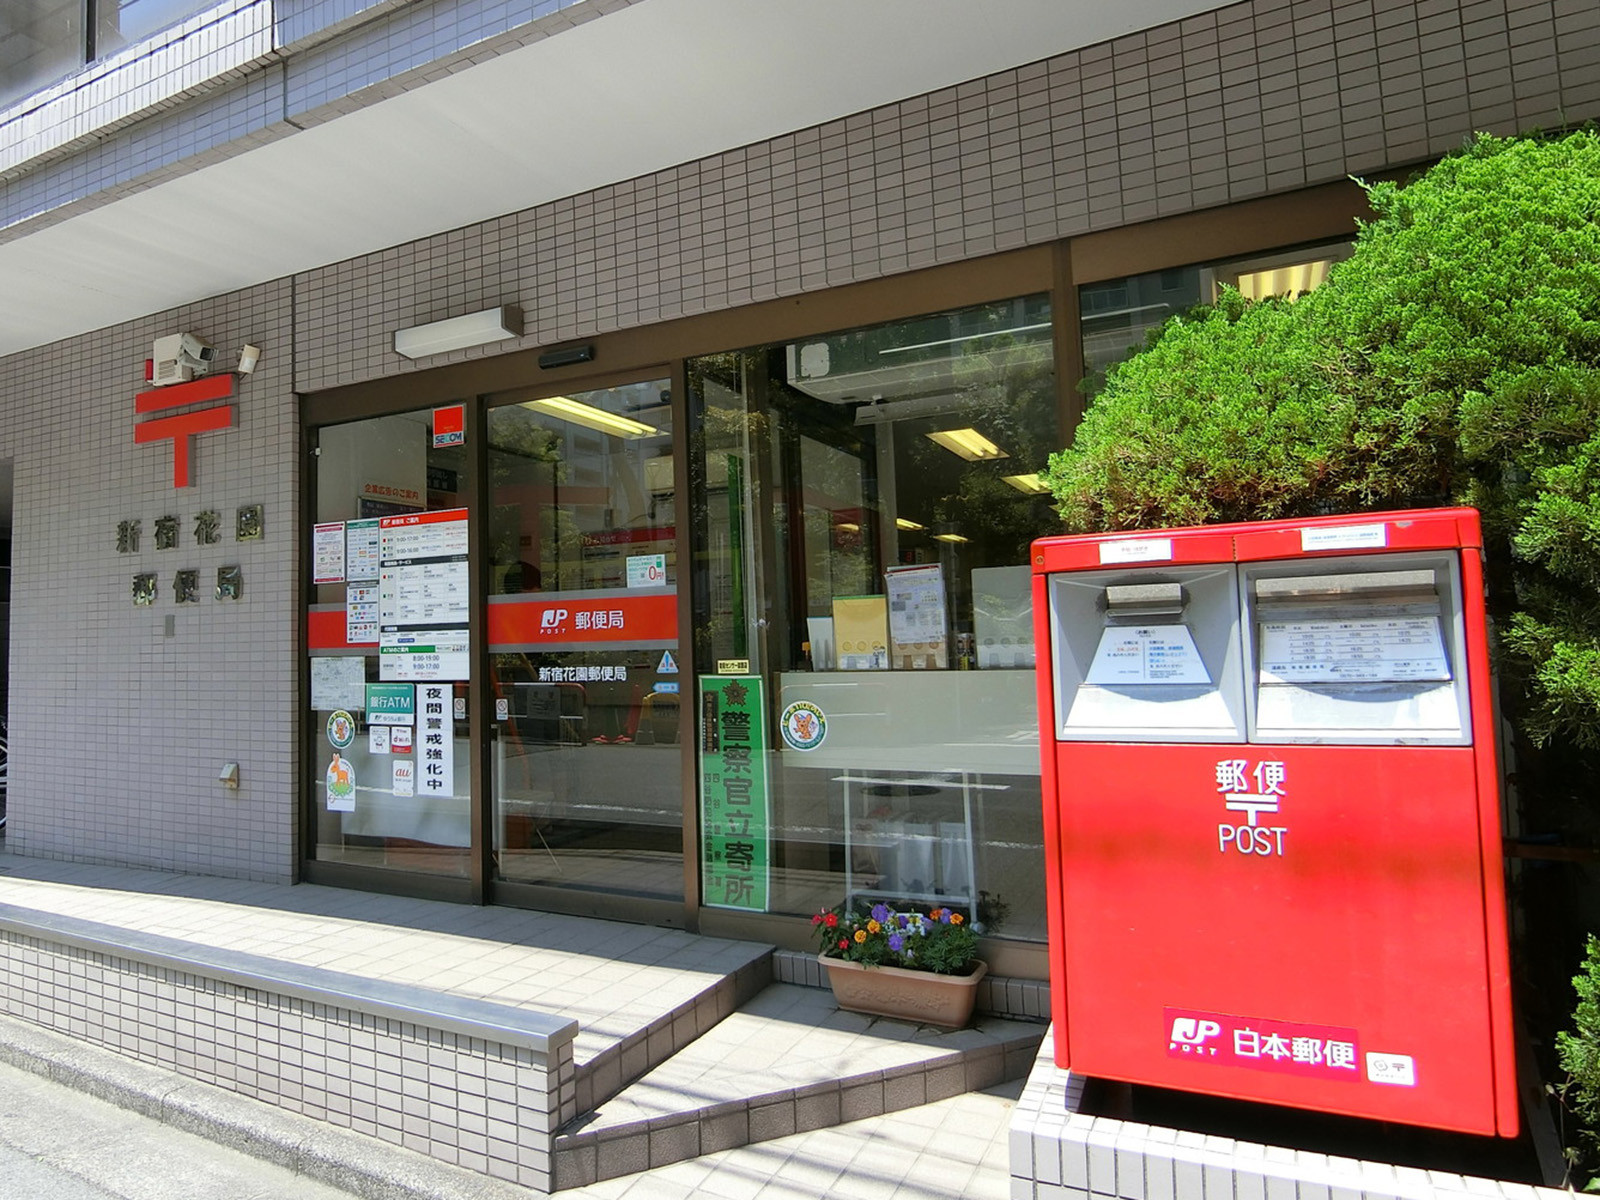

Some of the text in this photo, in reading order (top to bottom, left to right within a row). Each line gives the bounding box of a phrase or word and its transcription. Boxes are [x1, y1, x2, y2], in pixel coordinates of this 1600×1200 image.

[435, 432, 462, 444] SECOM
[541, 609, 624, 630] JP 郵便局
[539, 627, 566, 635] POST
[538, 666, 627, 682] 新宿花園郵便局
[370, 696, 410, 708] 銀行ATM
[426, 687, 443, 790] 夜間警戒強化中
[395, 768, 412, 777] au
[1215, 759, 1286, 796] 郵便
[720, 710, 755, 904] 警察官立寄所
[1218, 824, 1288, 856] POST
[1169, 1043, 1218, 1055] POST
[1171, 1017, 1356, 1069] JP 日本郵便
